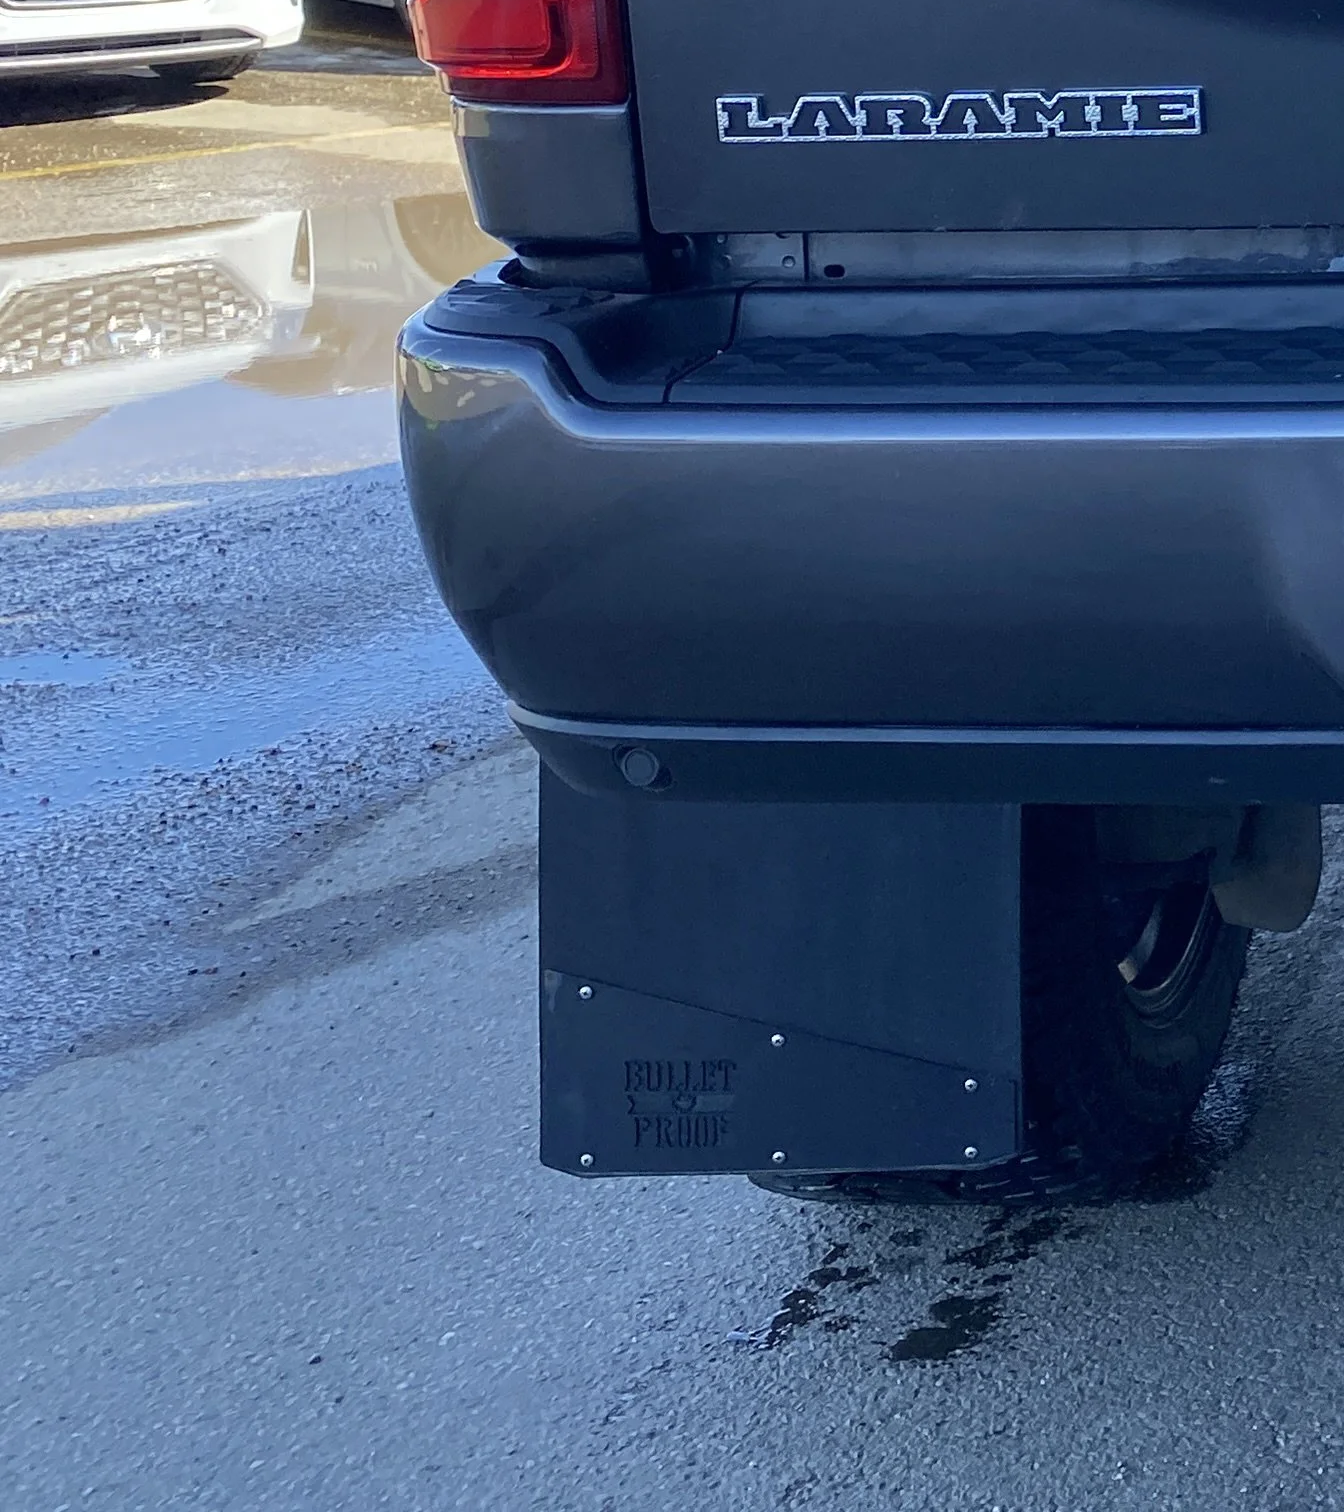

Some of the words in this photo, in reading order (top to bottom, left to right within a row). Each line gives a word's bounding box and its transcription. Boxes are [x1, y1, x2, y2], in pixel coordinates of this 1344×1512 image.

[715, 89, 1203, 143] LARAMIE
[623, 1058, 738, 1093] BULLET
[633, 1114, 730, 1149] PROOF
